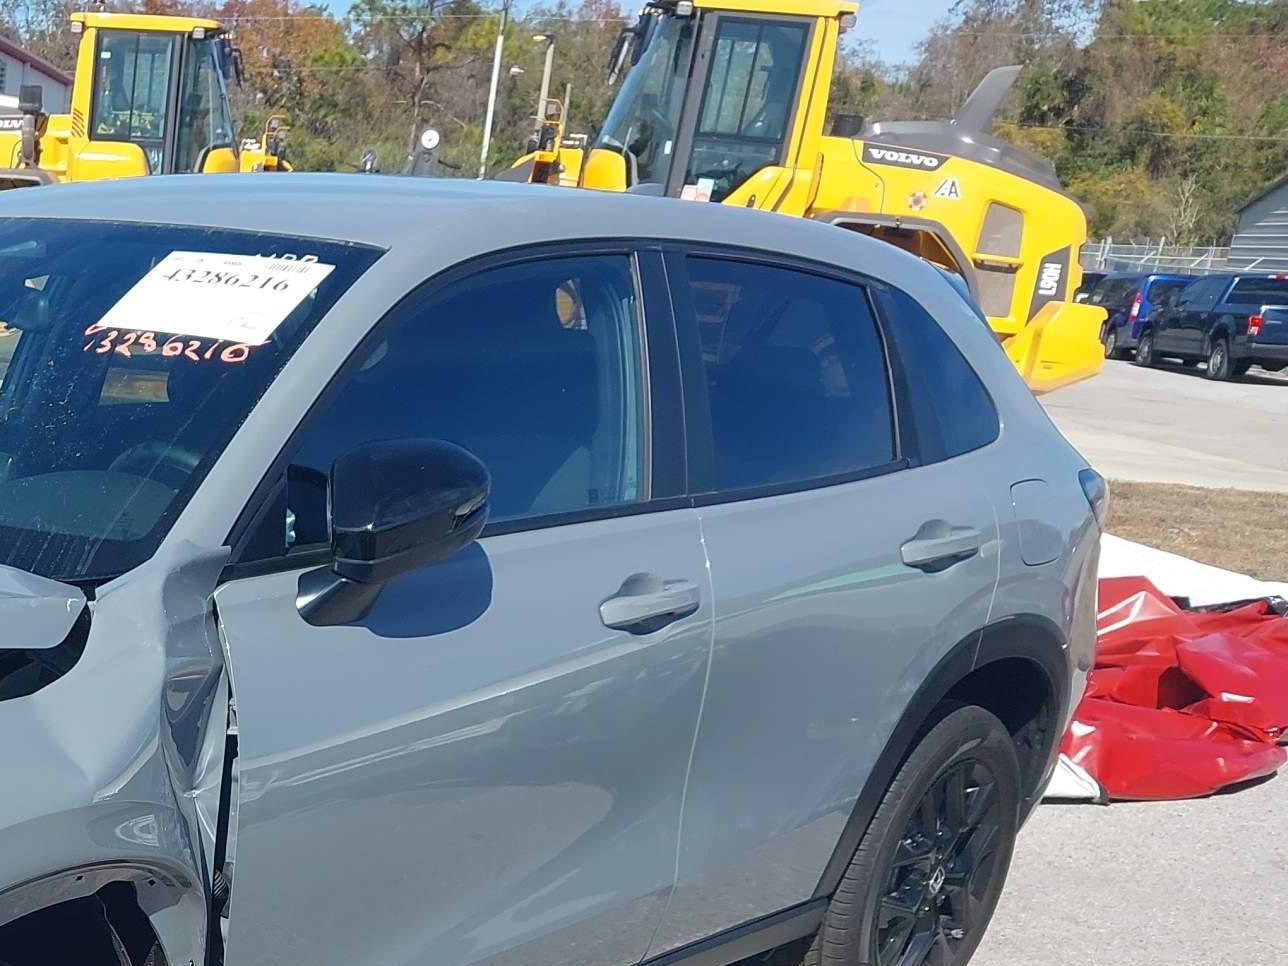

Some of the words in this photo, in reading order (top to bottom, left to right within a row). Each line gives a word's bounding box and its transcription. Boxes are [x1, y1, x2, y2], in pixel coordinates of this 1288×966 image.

[868, 148, 939, 167] VOLVO
[162, 268, 289, 292] 43286216
[1038, 262, 1063, 296] L90H
